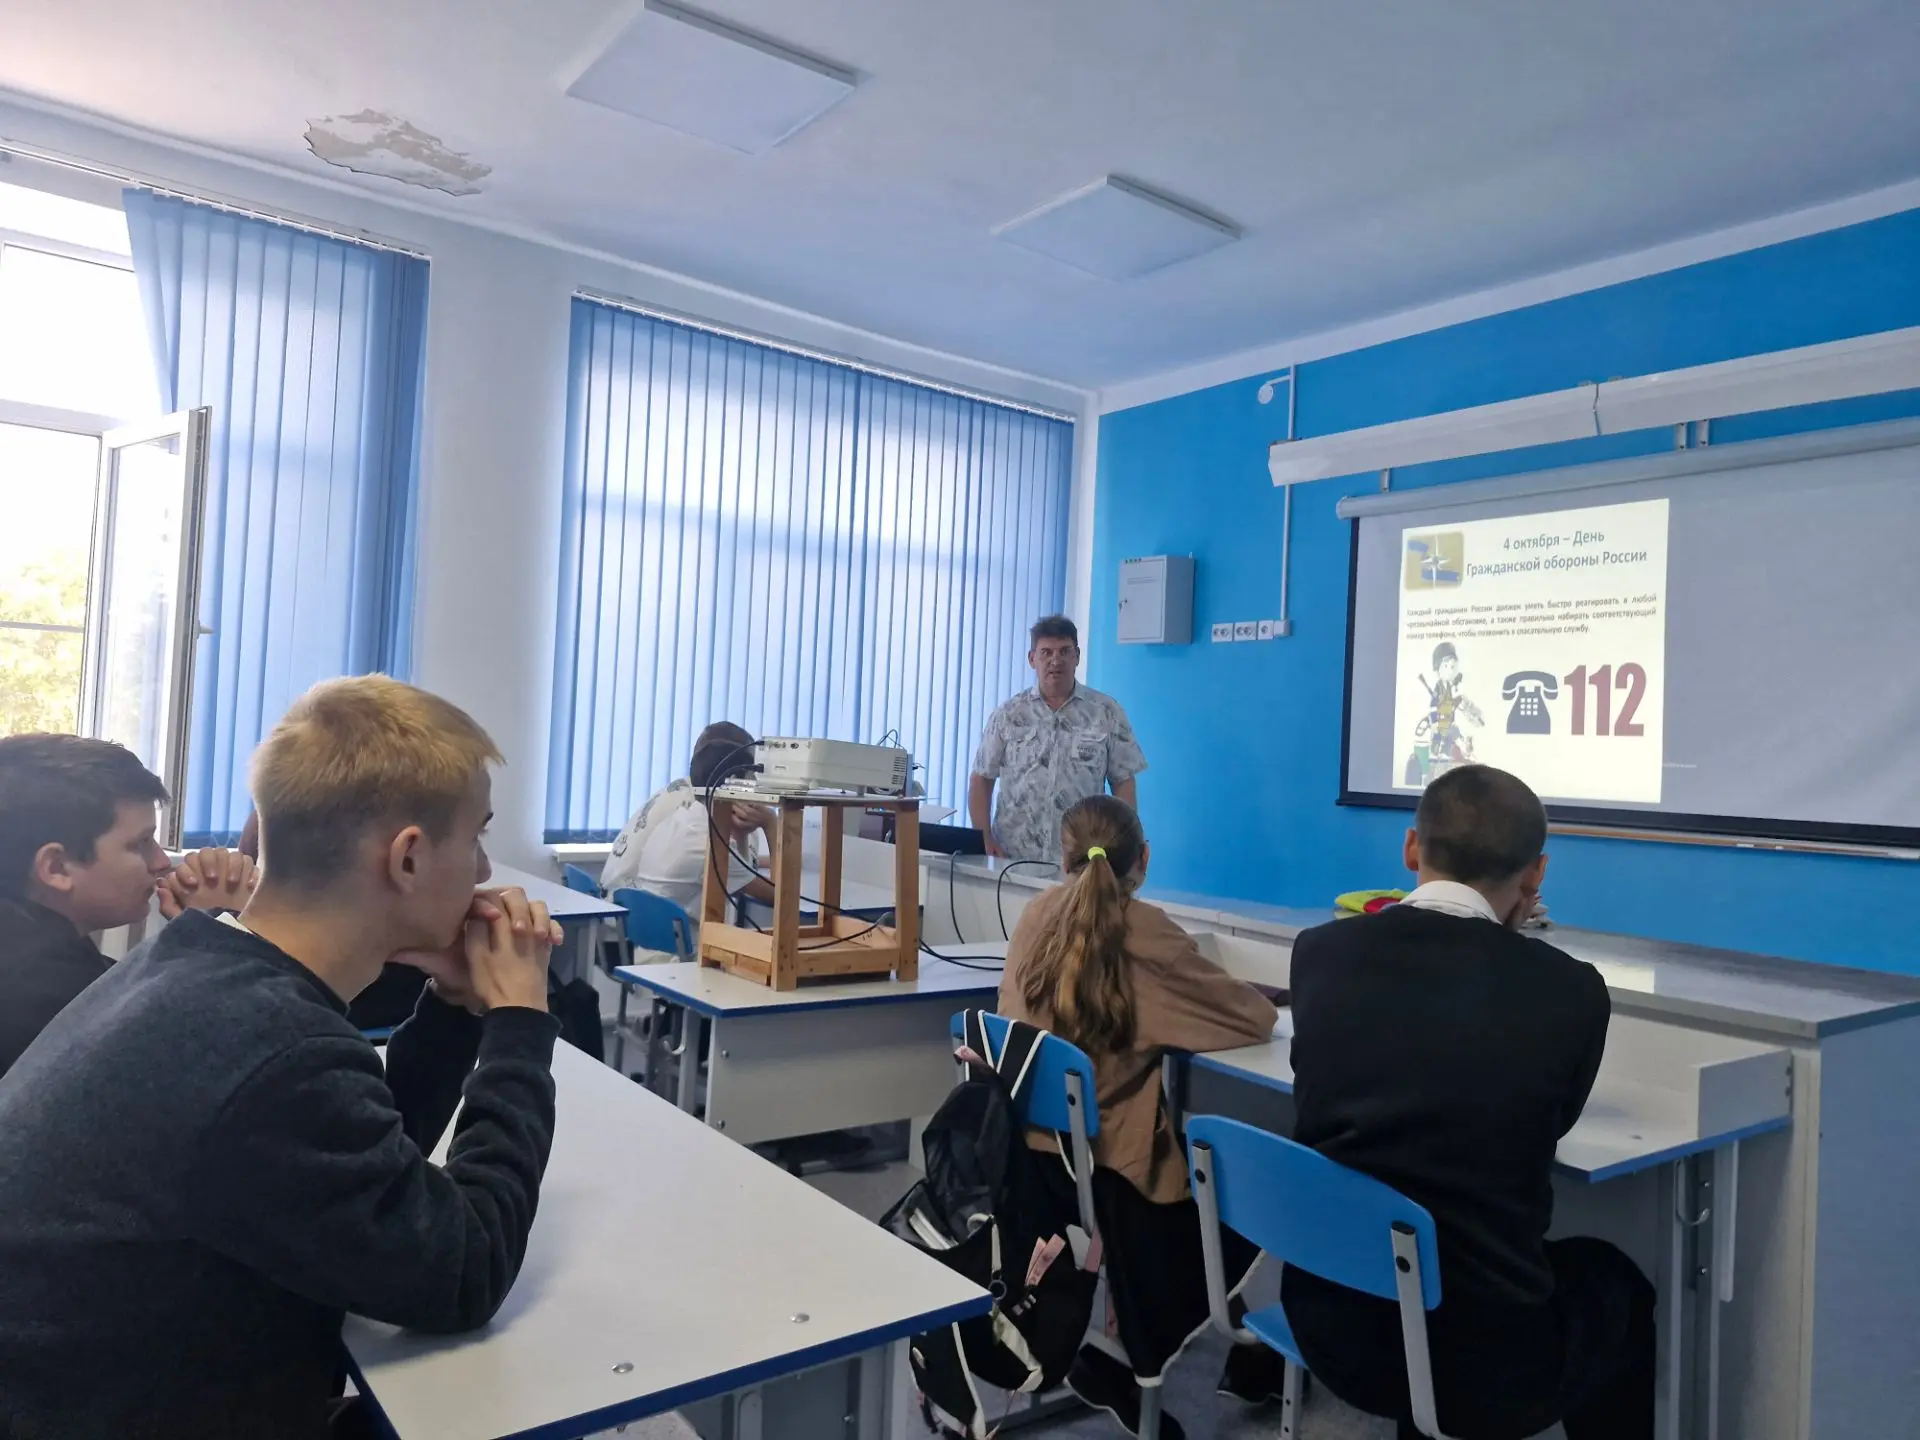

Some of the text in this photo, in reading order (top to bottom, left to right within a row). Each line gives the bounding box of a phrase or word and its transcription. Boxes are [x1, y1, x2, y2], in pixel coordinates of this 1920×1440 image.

[1503, 538, 1510, 550] 4
[1513, 533, 1560, 550] октября
[1572, 531, 1604, 546] День
[1466, 551, 1647, 578] Гражданской обороны России
[1471, 605, 1493, 613] России
[1524, 602, 1544, 611] уметь
[1547, 599, 1572, 609] быстро
[1575, 598, 1619, 608] реагировать
[1631, 592, 1657, 604] любой
[1497, 615, 1517, 623] также
[1519, 613, 1554, 623] правильно
[1557, 612, 1589, 621] набирать
[1592, 607, 1656, 619] соответствующий
[1457, 629, 1476, 637] чтобы
[1517, 625, 1562, 636] спасательную
[1563, 662, 1647, 736] 112
